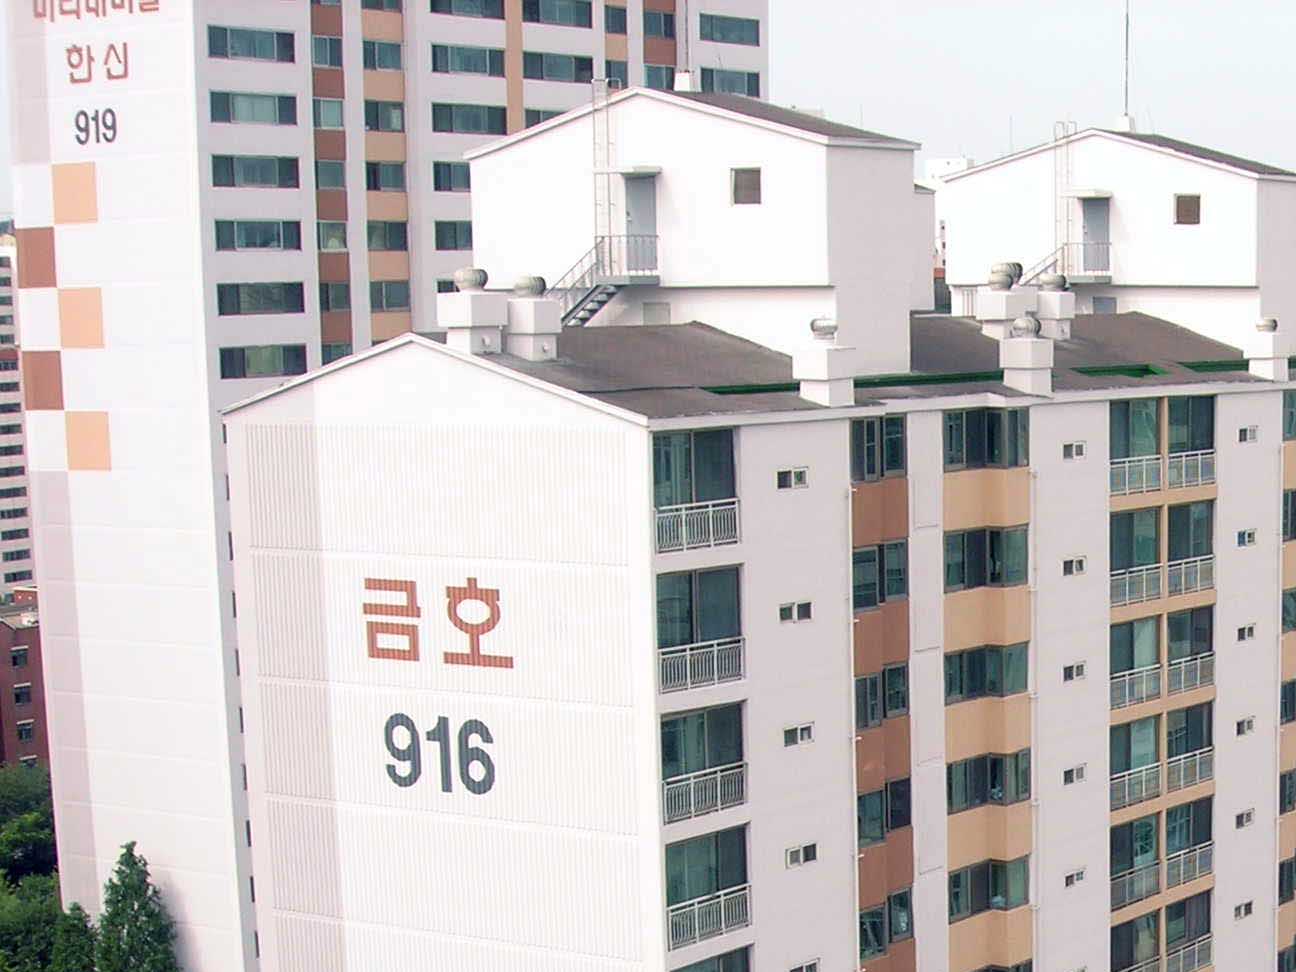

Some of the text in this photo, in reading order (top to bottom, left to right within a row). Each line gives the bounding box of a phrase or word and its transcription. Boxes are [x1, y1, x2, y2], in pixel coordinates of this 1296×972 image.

[66, 42, 129, 84] 한신
[75, 108, 117, 145] 919
[363, 577, 514, 669] 금호
[384, 713, 495, 795] 916
